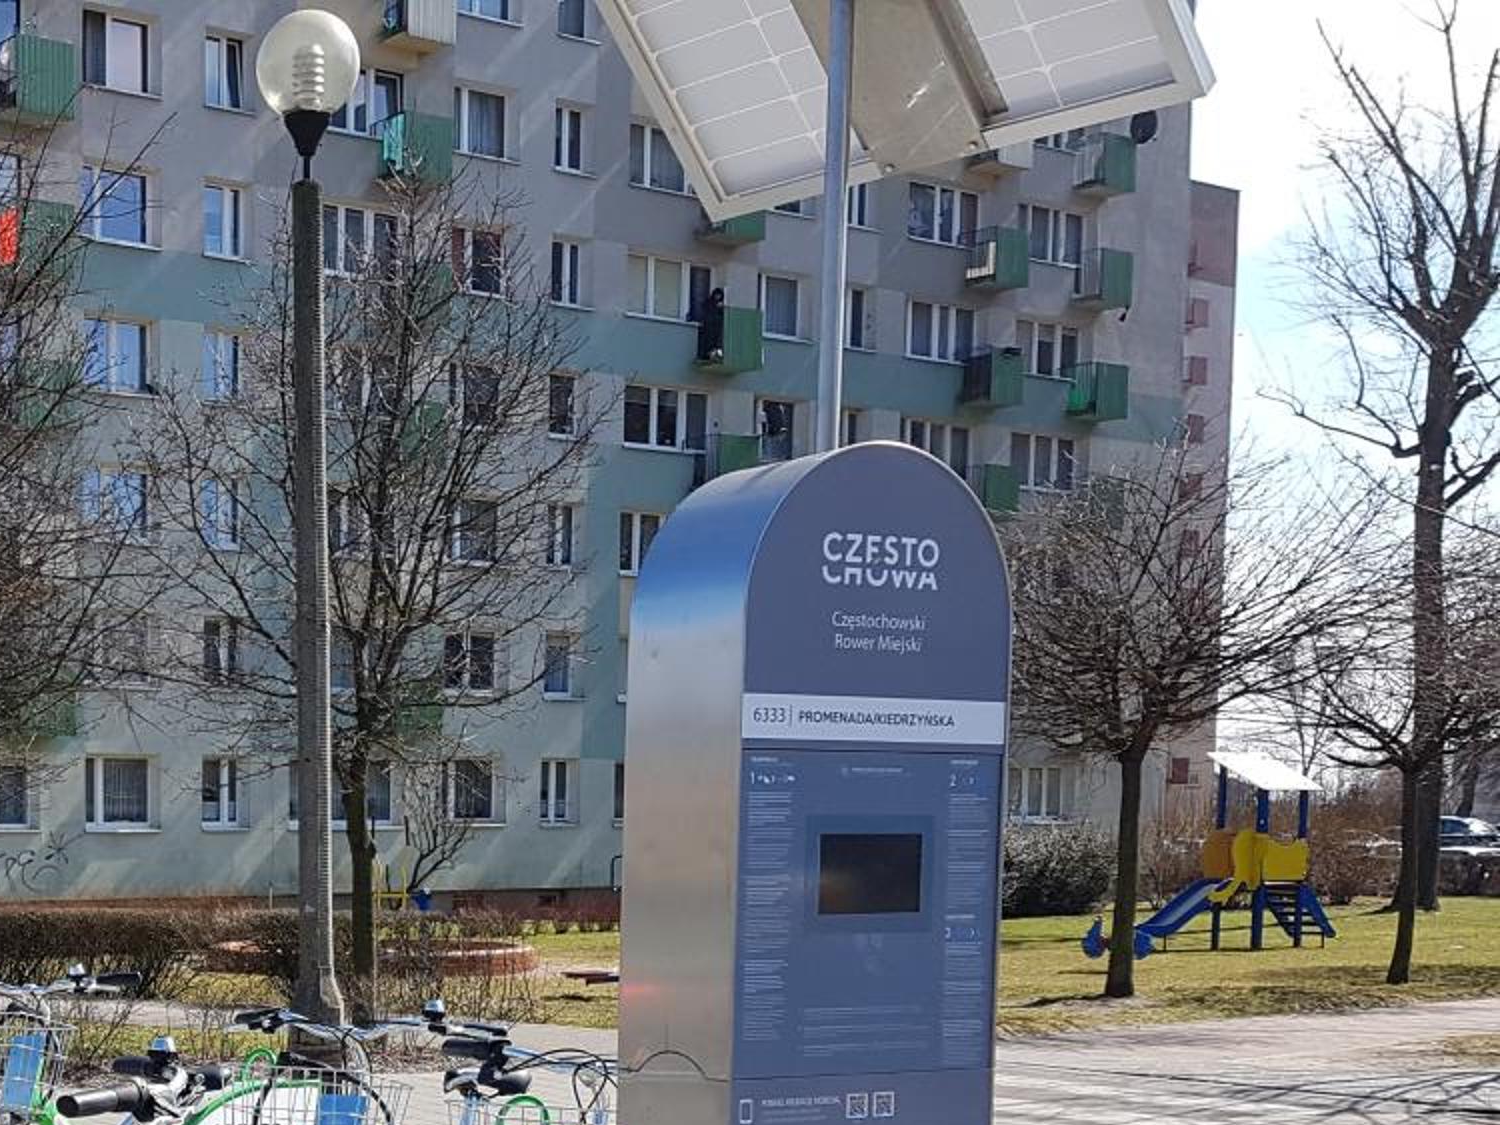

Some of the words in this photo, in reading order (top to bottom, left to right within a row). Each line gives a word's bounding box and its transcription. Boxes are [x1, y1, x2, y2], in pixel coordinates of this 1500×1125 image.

[822, 566, 939, 590] CHOWA
[831, 611, 927, 632] Częstochowski
[834, 633, 875, 651] Rower
[877, 635, 923, 653] Miejski
[753, 706, 786, 723] 6333
